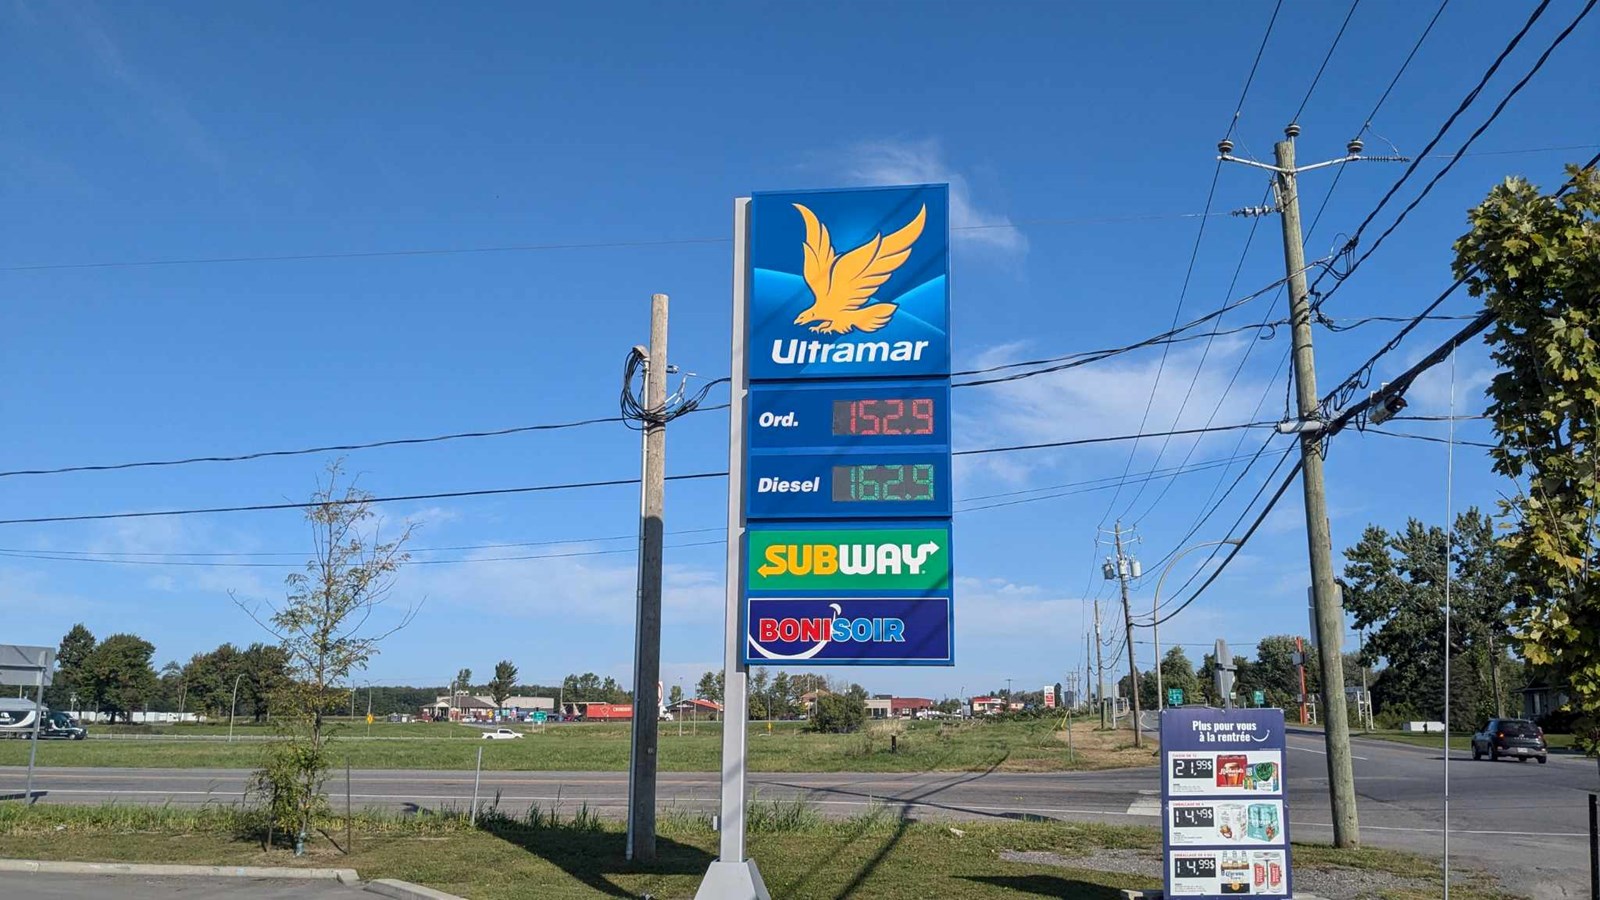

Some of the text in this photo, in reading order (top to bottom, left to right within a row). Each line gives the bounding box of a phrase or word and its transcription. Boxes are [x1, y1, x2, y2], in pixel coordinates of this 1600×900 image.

[771, 339, 929, 365] Ultramar
[758, 412, 800, 428] Ord.
[850, 398, 934, 435] 152.9
[757, 477, 820, 493] Diesel
[850, 464, 934, 501] 162.9
[757, 541, 940, 578] SUBWAY
[759, 617, 906, 643] BONISOIR
[1192, 720, 1257, 733] Plus pour vous
[1199, 731, 1251, 742] à la rentrée
